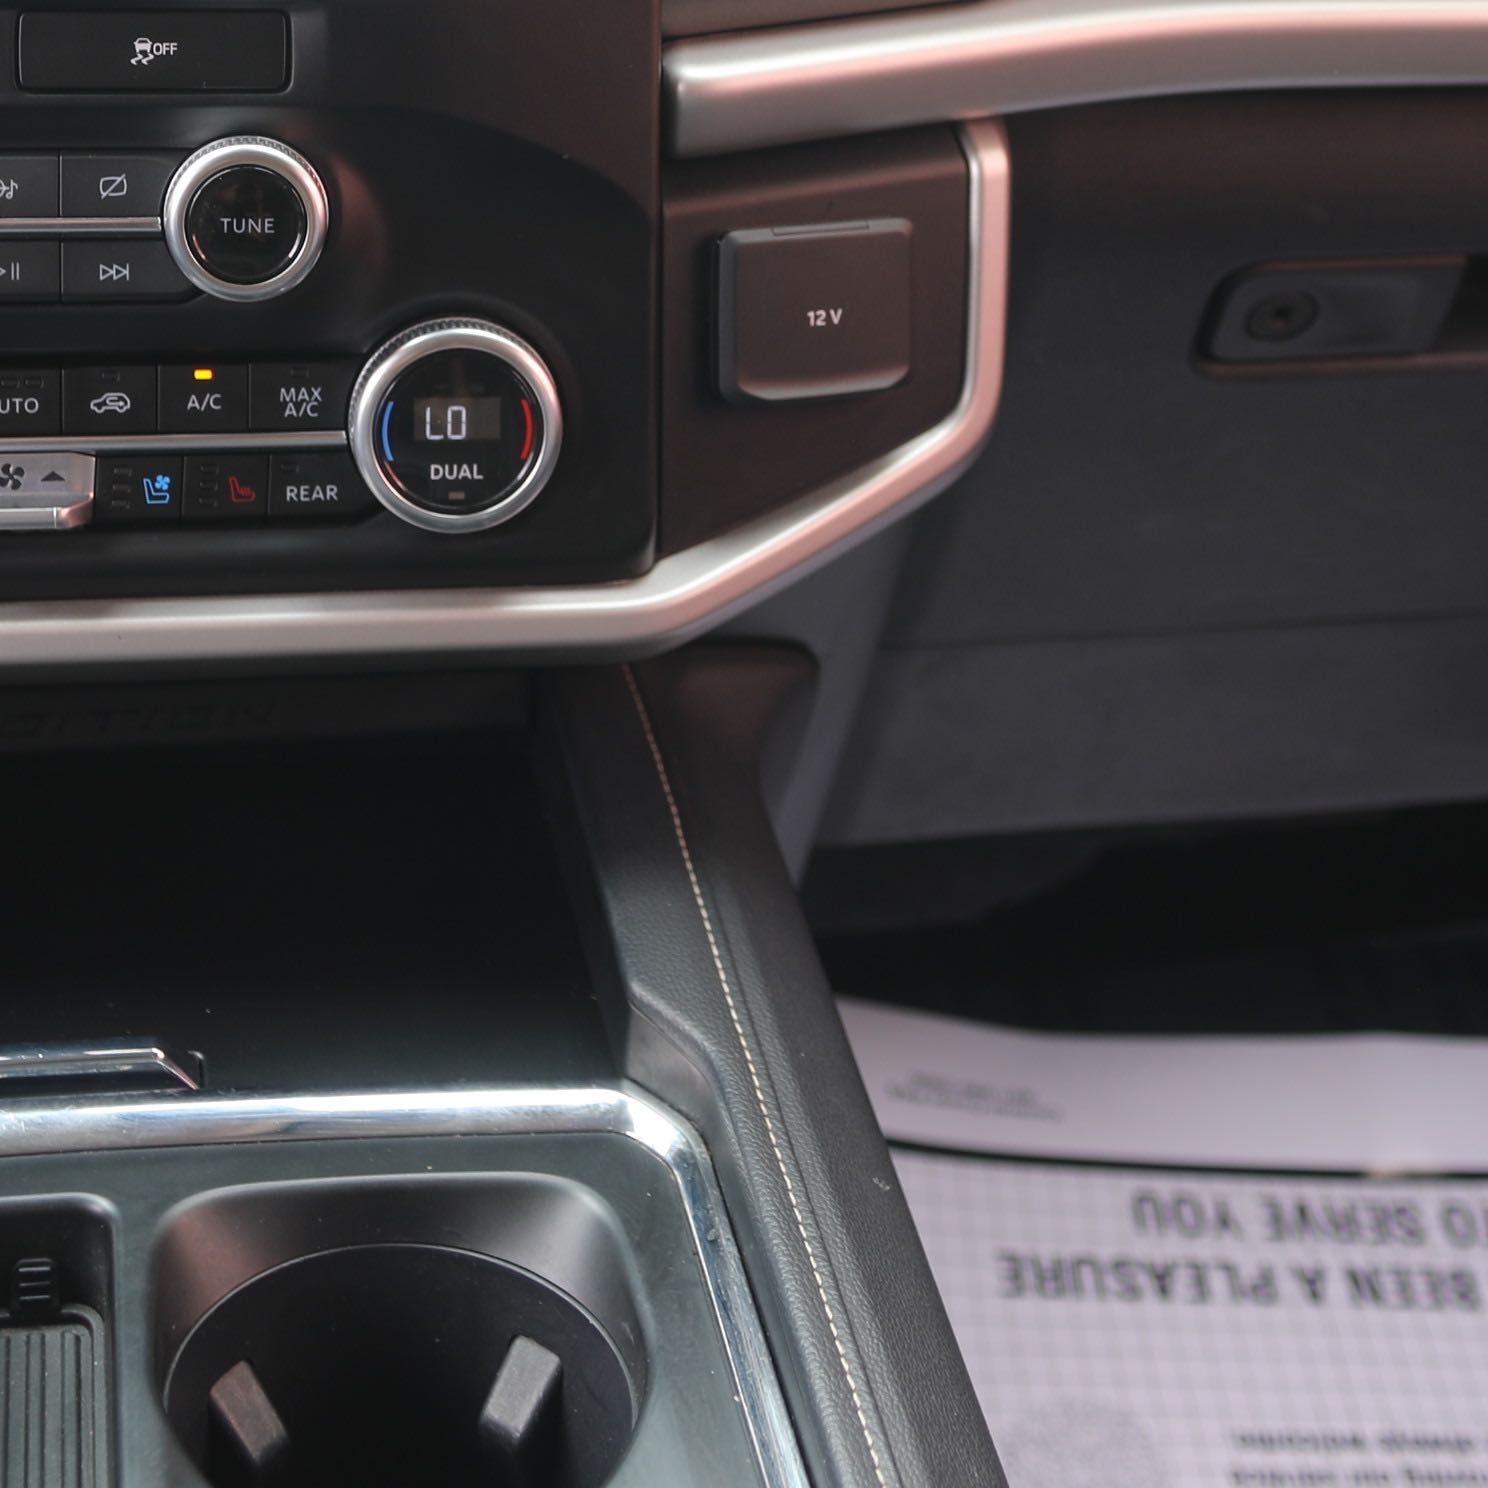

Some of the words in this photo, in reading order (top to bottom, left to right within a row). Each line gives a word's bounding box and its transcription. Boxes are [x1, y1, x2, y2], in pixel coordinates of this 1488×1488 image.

[152, 41, 179, 58] OFF
[220, 216, 275, 235] TUNE
[807, 309, 827, 327] 12
[829, 308, 843, 325] V
[187, 393, 222, 412] A/C
[279, 387, 323, 403] MAX
[284, 401, 319, 419] A/C
[429, 463, 484, 481] DUAL
[286, 484, 339, 502] REAR
[1129, 1185, 1250, 1241] YOU
[1263, 1190, 1428, 1246] SERVE
[996, 1248, 1278, 1306] PLEASURE
[1291, 1263, 1328, 1304] A
[1347, 1261, 1482, 1310] BEEN
